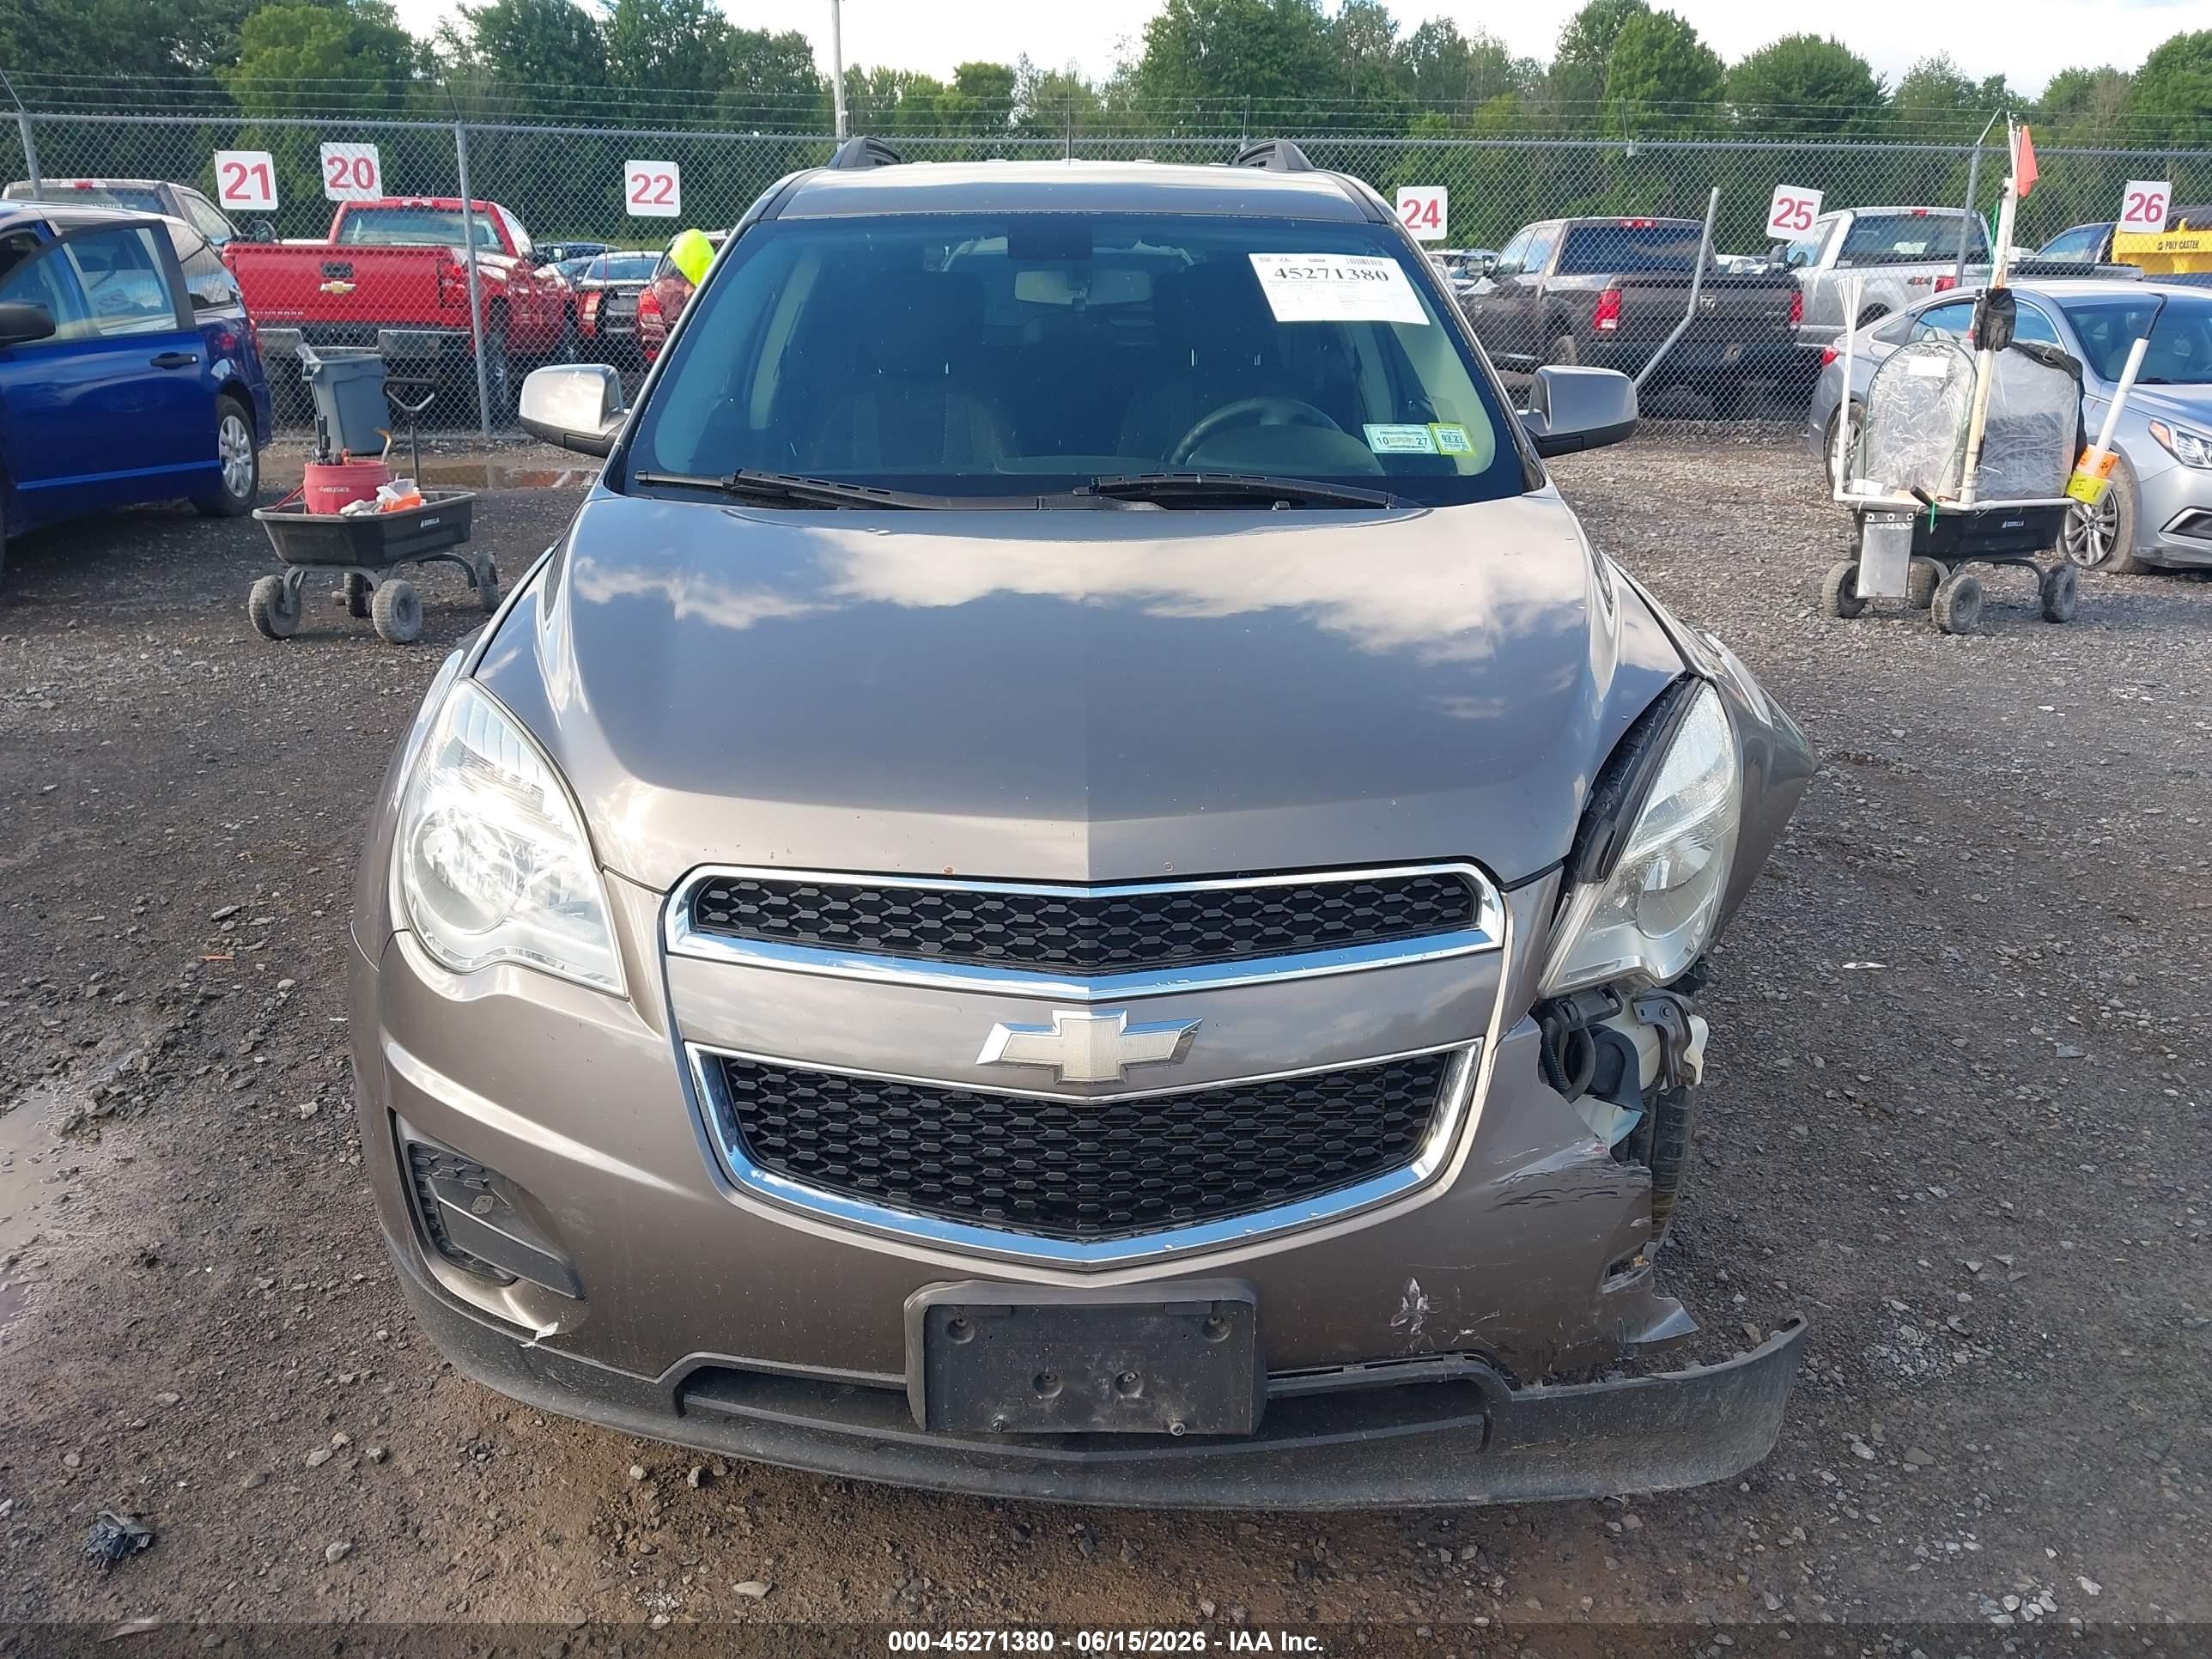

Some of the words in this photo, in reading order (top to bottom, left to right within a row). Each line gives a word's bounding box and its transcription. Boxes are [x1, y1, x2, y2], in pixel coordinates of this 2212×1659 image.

[222, 162, 271, 200] 21
[327, 156, 375, 190] 20
[631, 173, 674, 205] 22
[1402, 199, 1442, 229] 24
[1772, 198, 1814, 231] 25
[2124, 192, 2165, 223] 26
[1274, 267, 1389, 282] 45271380
[1376, 437, 1389, 446] 10
[1415, 437, 1428, 446] 27
